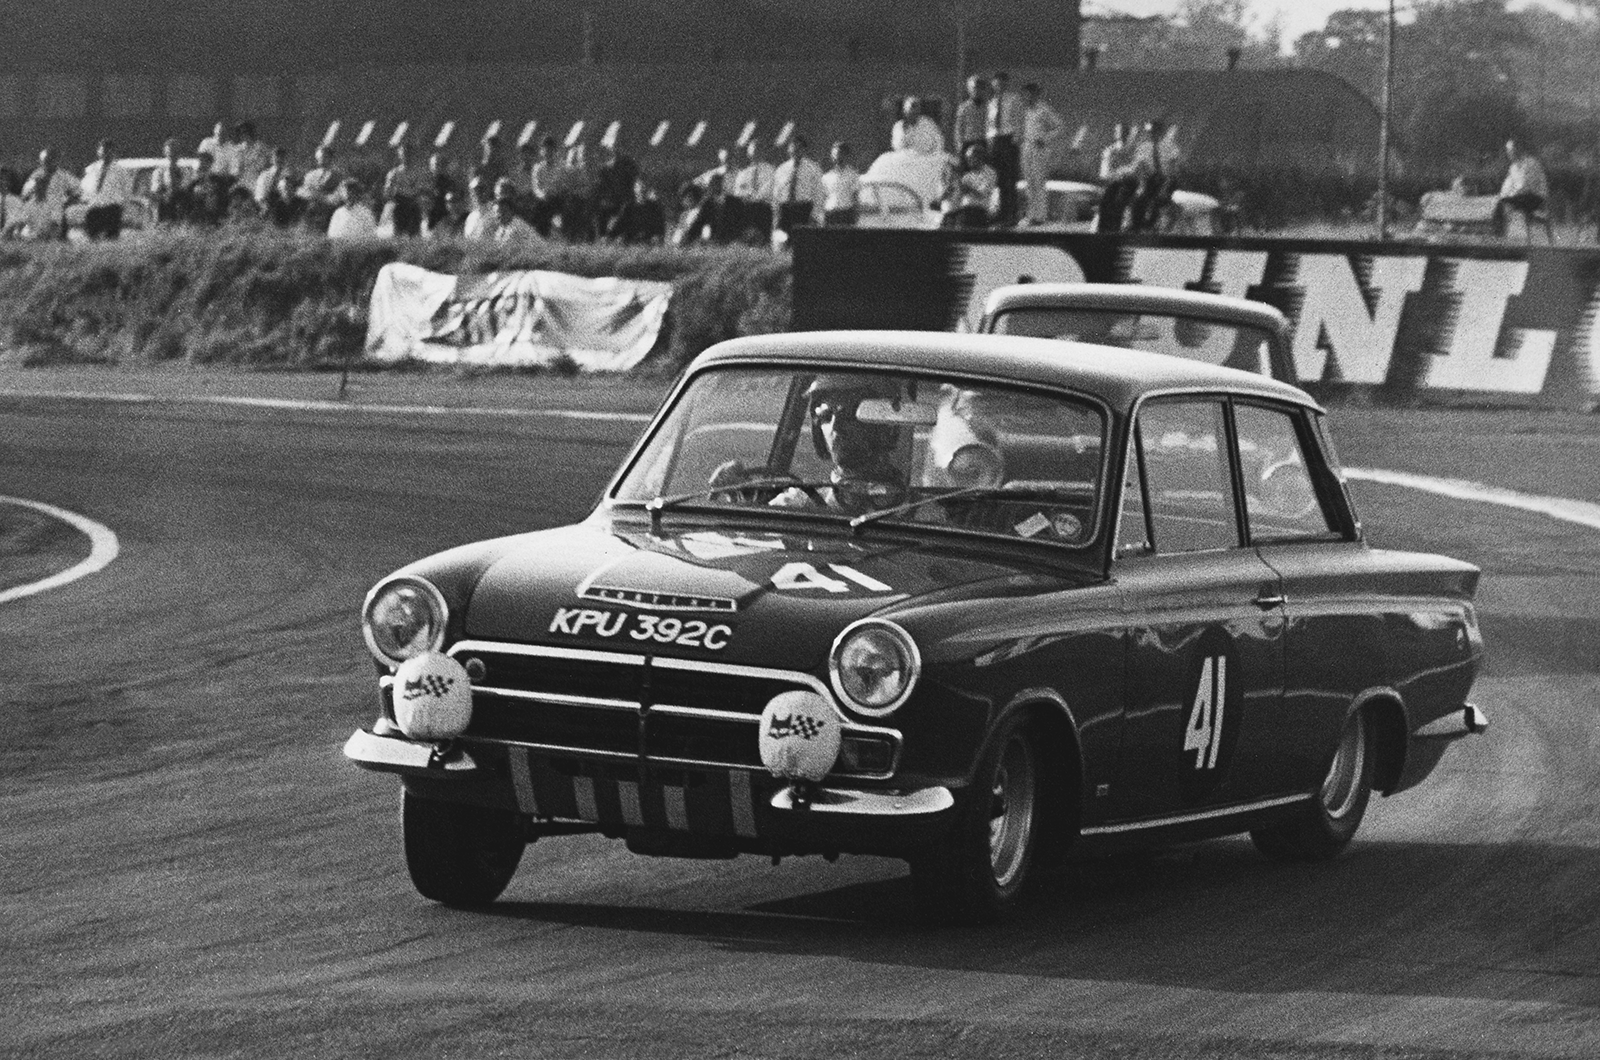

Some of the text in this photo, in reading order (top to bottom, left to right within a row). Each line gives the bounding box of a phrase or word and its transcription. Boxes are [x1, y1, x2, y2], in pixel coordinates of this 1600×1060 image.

[948, 243, 1600, 394] DUNL
[549, 608, 733, 650] KPU 392C
[1183, 655, 1226, 769] 41
